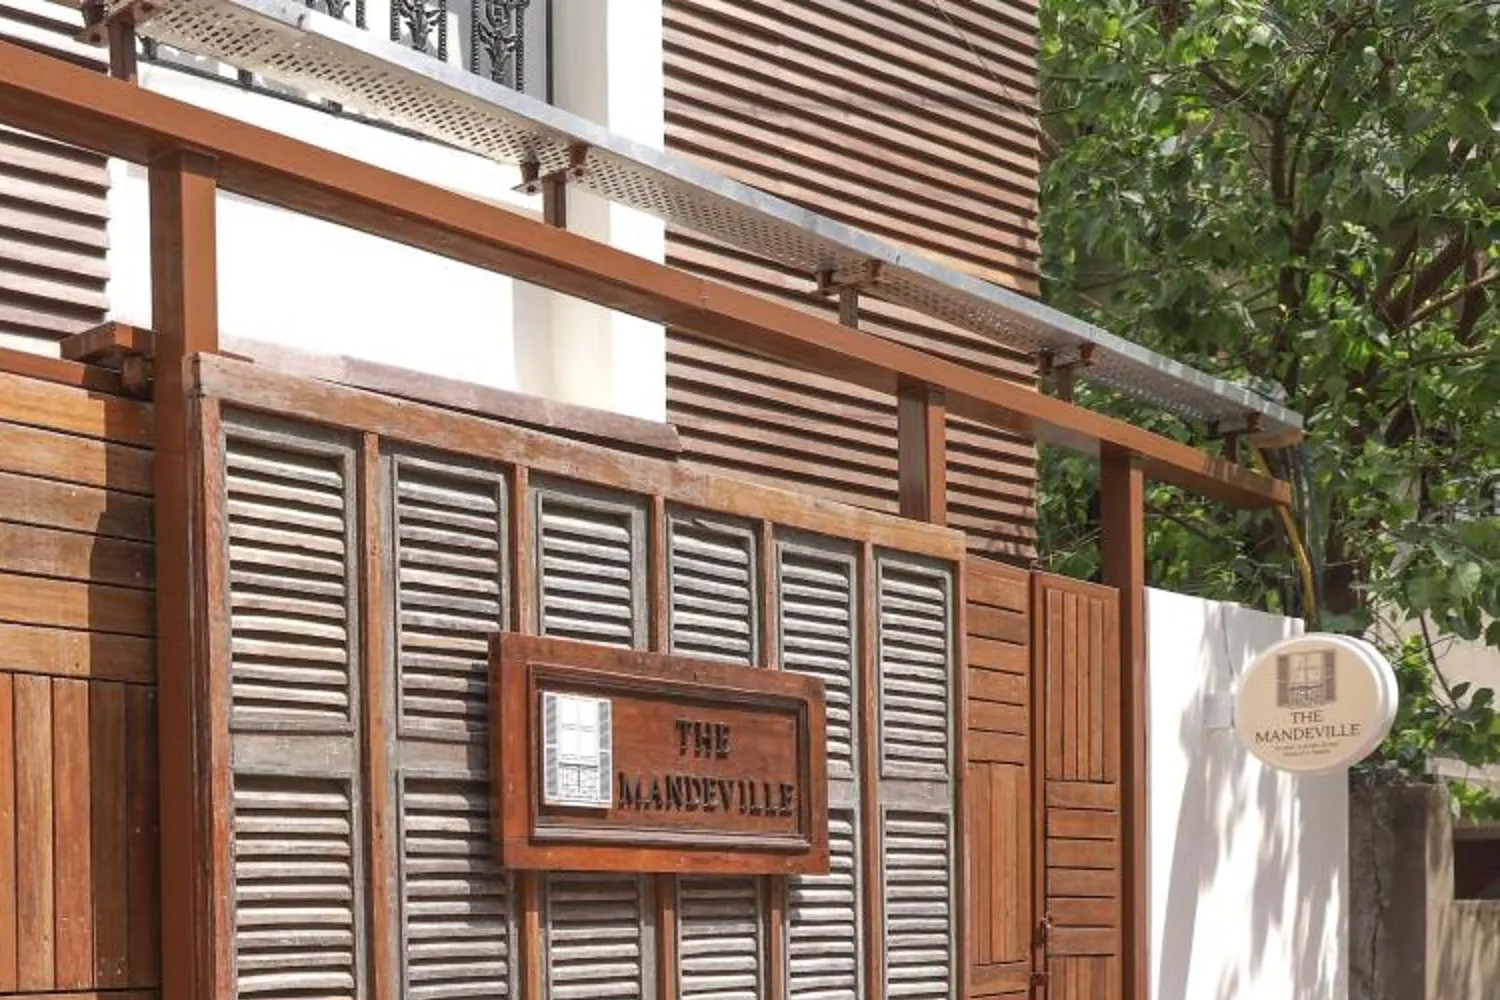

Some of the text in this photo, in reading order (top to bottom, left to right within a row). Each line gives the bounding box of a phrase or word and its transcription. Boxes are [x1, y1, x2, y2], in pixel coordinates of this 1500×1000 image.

[1290, 709, 1324, 725] THE
[675, 719, 731, 760] THE
[1255, 723, 1361, 744] MANDEVILLE
[617, 771, 795, 817] MANDEVILLE
